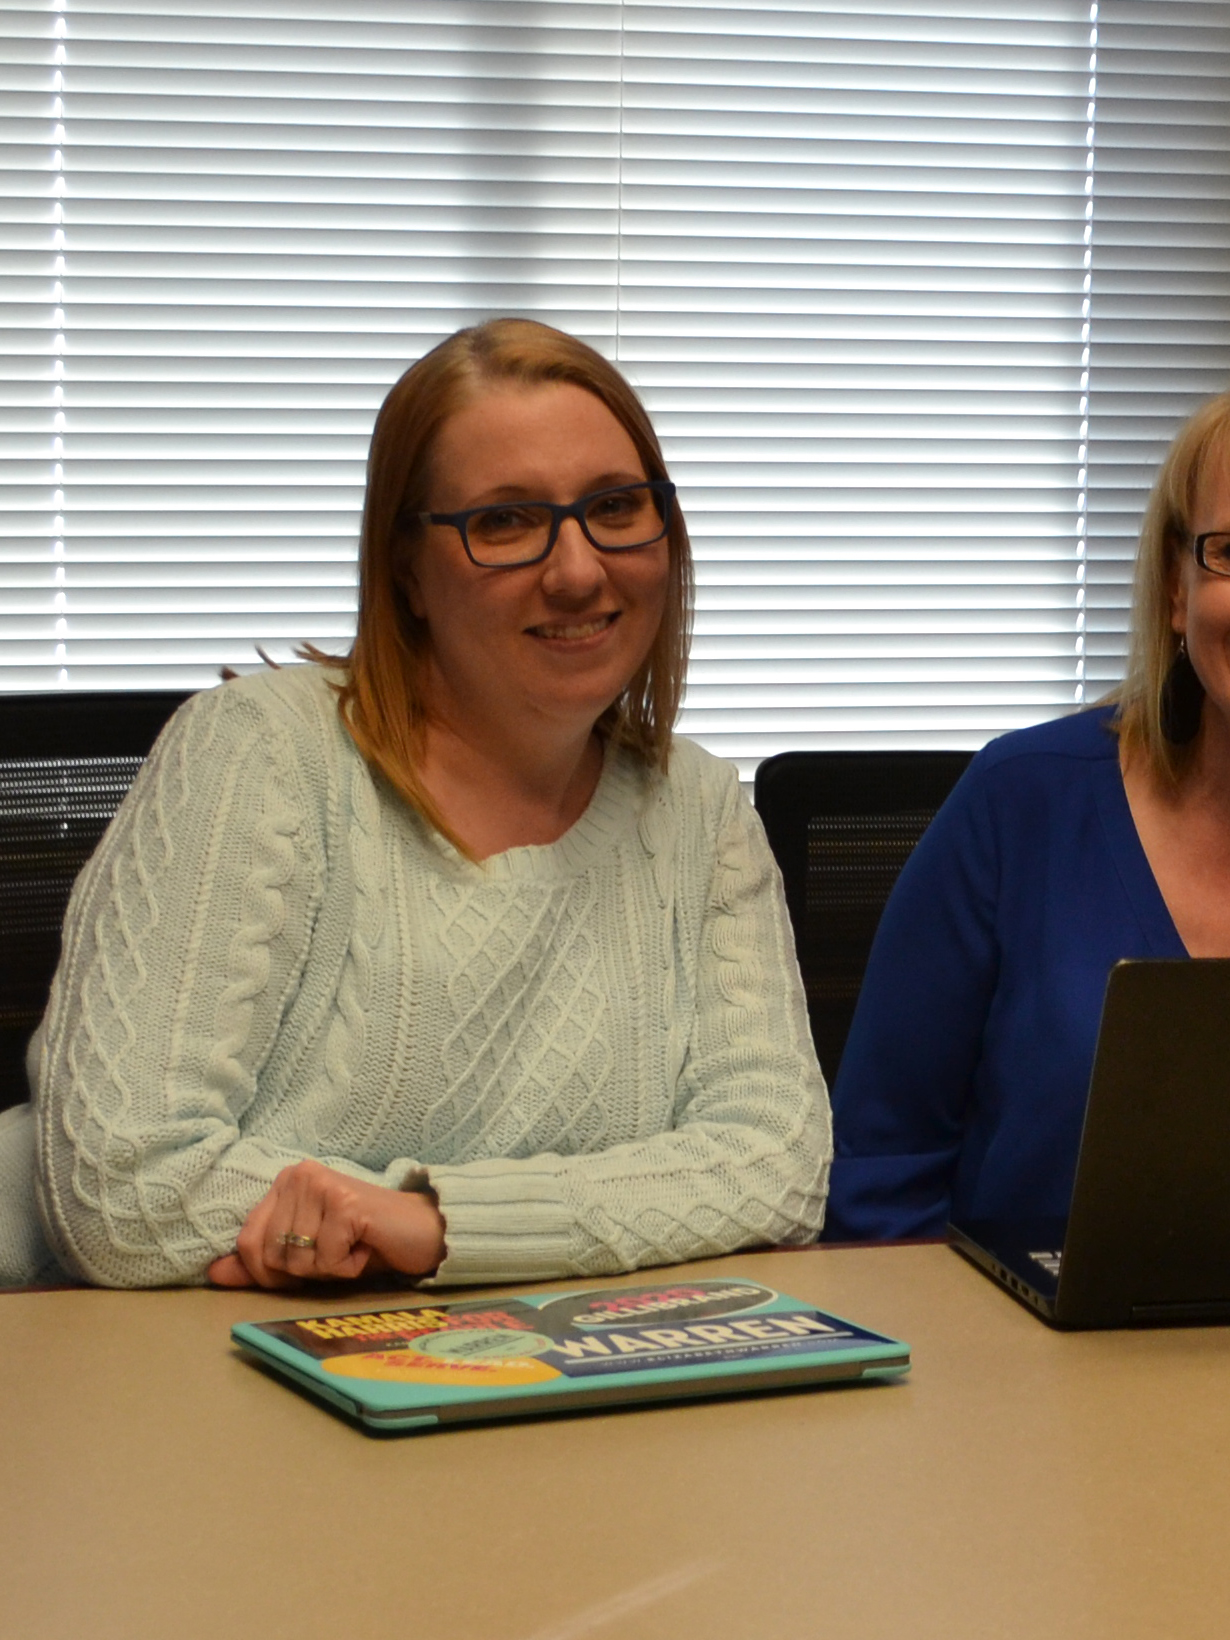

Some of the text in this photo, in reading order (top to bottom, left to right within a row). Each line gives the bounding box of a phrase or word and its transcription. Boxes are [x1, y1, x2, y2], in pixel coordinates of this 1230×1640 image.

[571, 1287, 761, 1323] GILLIBRAND
[589, 1287, 706, 1313] 2020
[296, 1308, 449, 1329] KAMALA
[312, 1317, 449, 1339] HARRIS
[550, 1315, 836, 1358] WARREN
